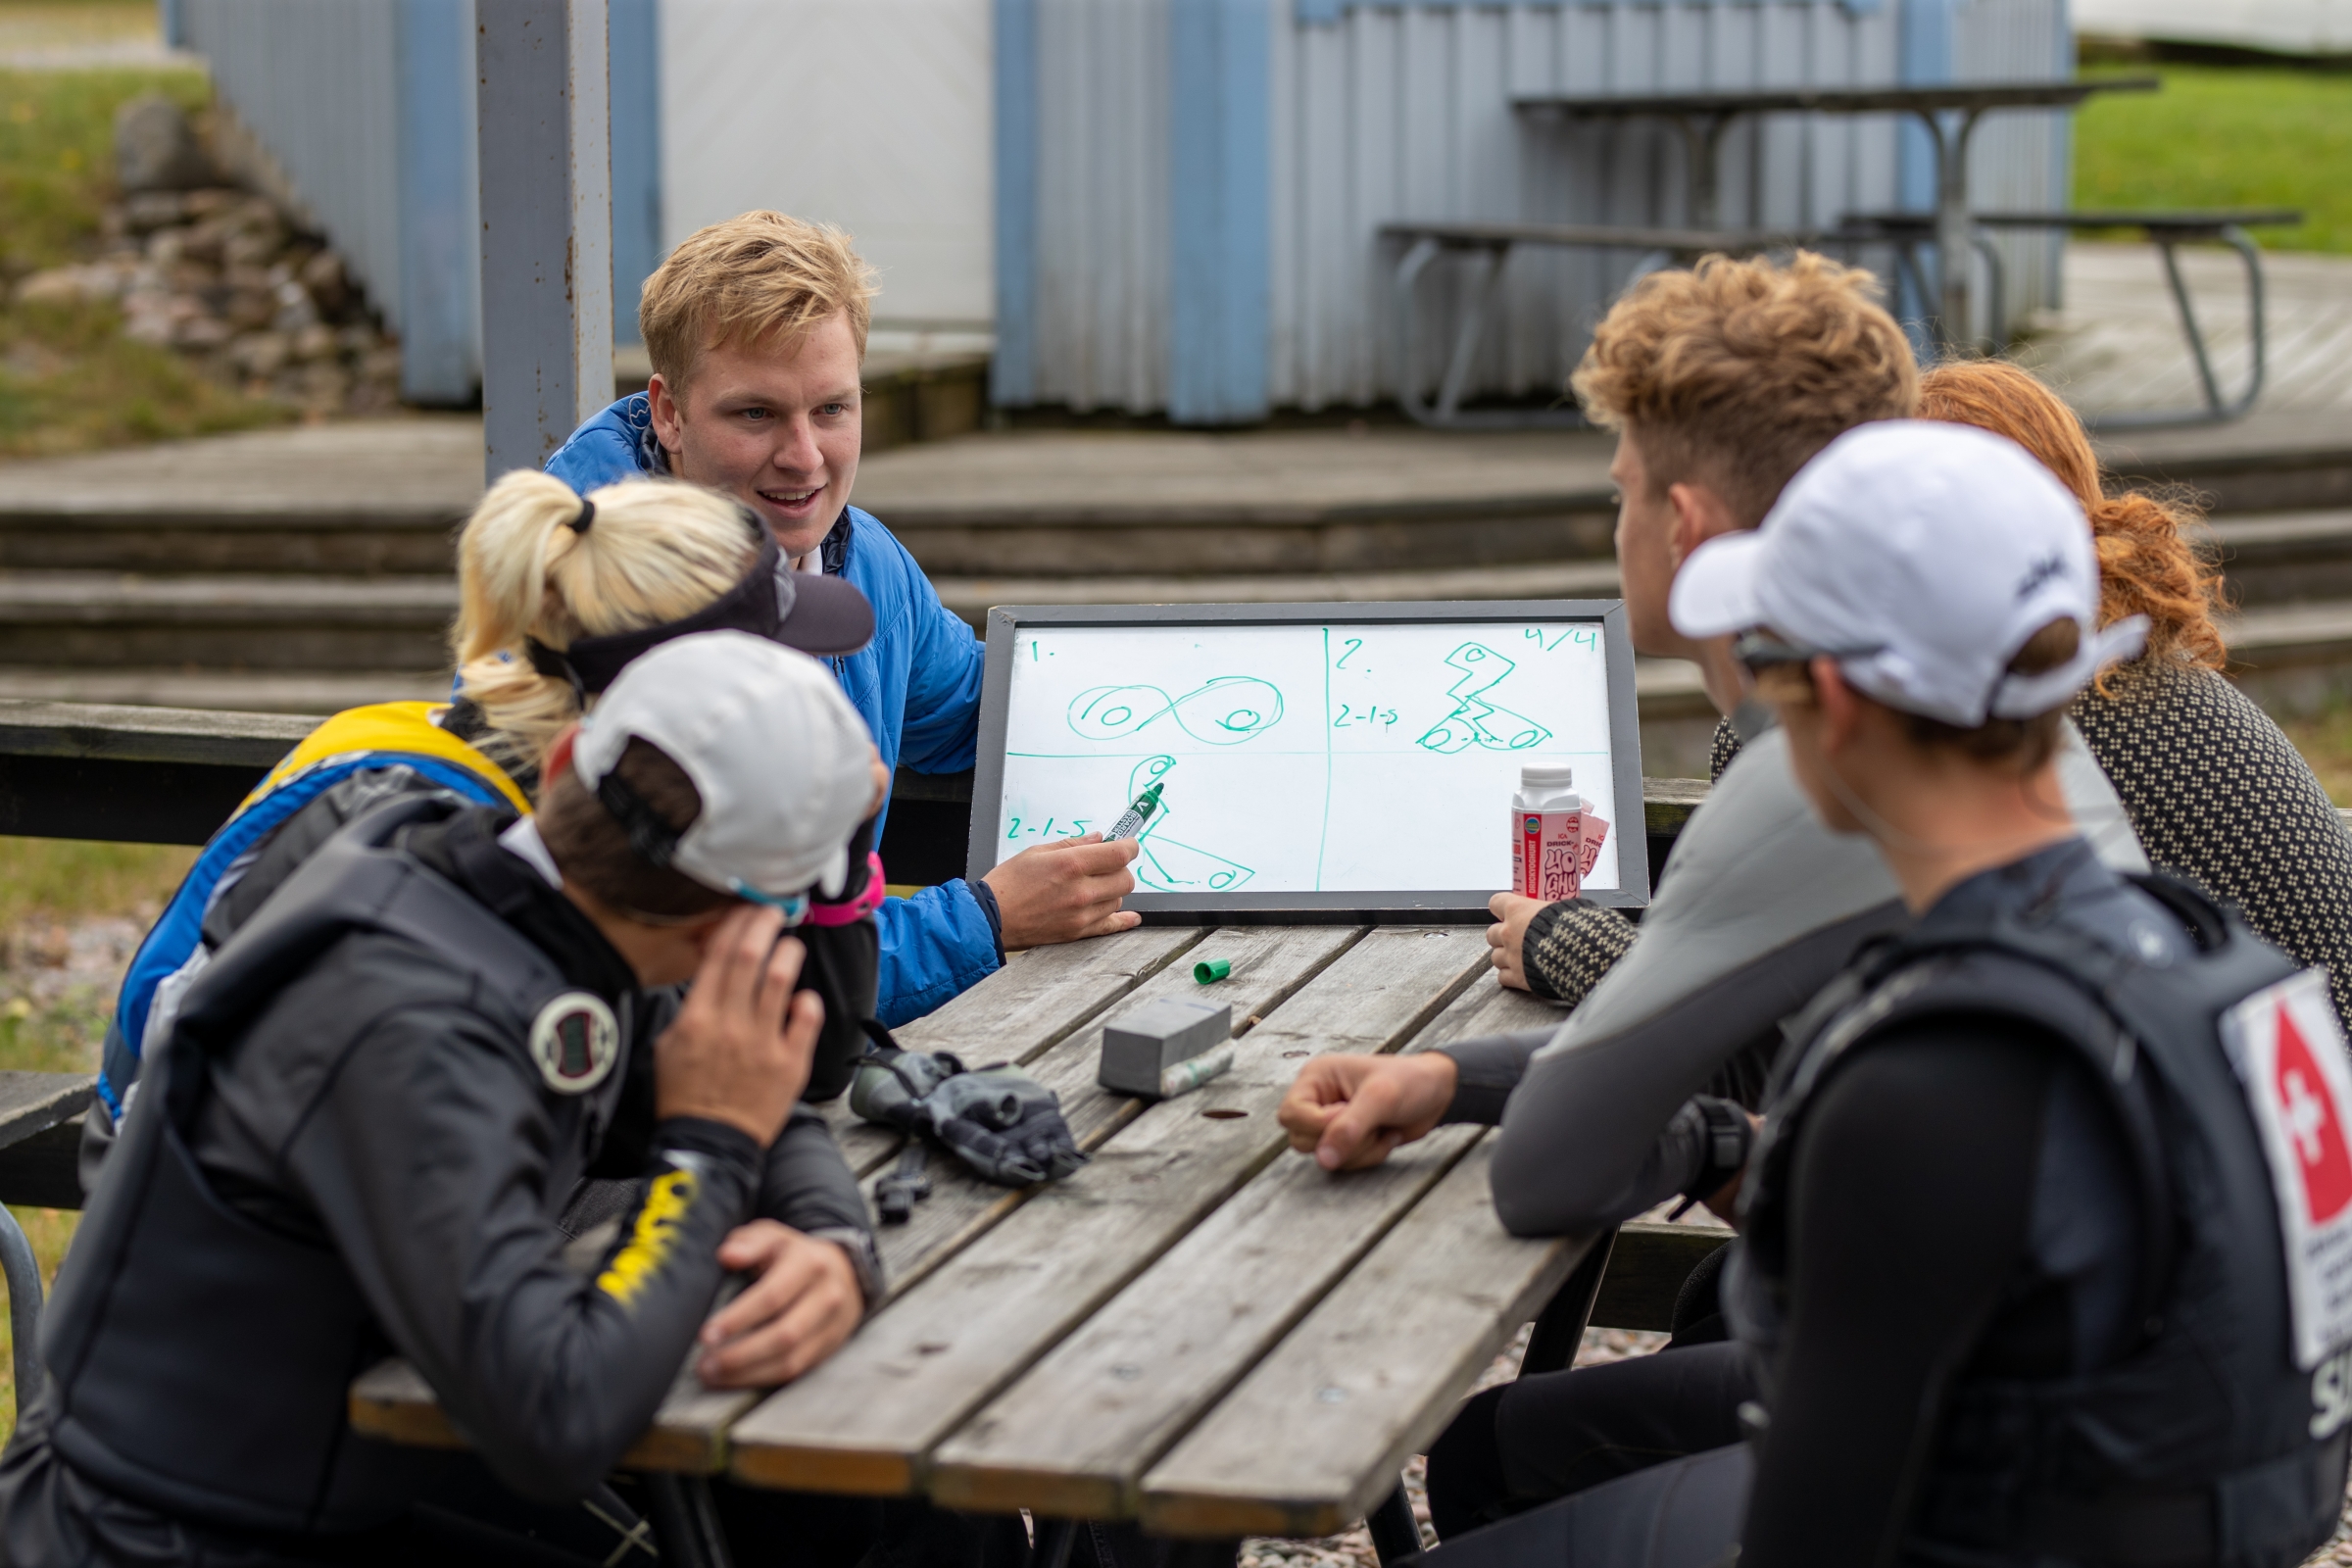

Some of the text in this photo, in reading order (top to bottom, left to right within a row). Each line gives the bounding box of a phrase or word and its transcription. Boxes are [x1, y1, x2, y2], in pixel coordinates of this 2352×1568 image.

[1032, 641, 1054, 662] 1.
[1525, 629, 1595, 652] 4/4
[1007, 817, 1093, 839] 2-1-5
[1112, 810, 1132, 833] MASTER
[1117, 811, 1138, 836] BOARD
[1528, 840, 1537, 894] DRICKYOGHURT
